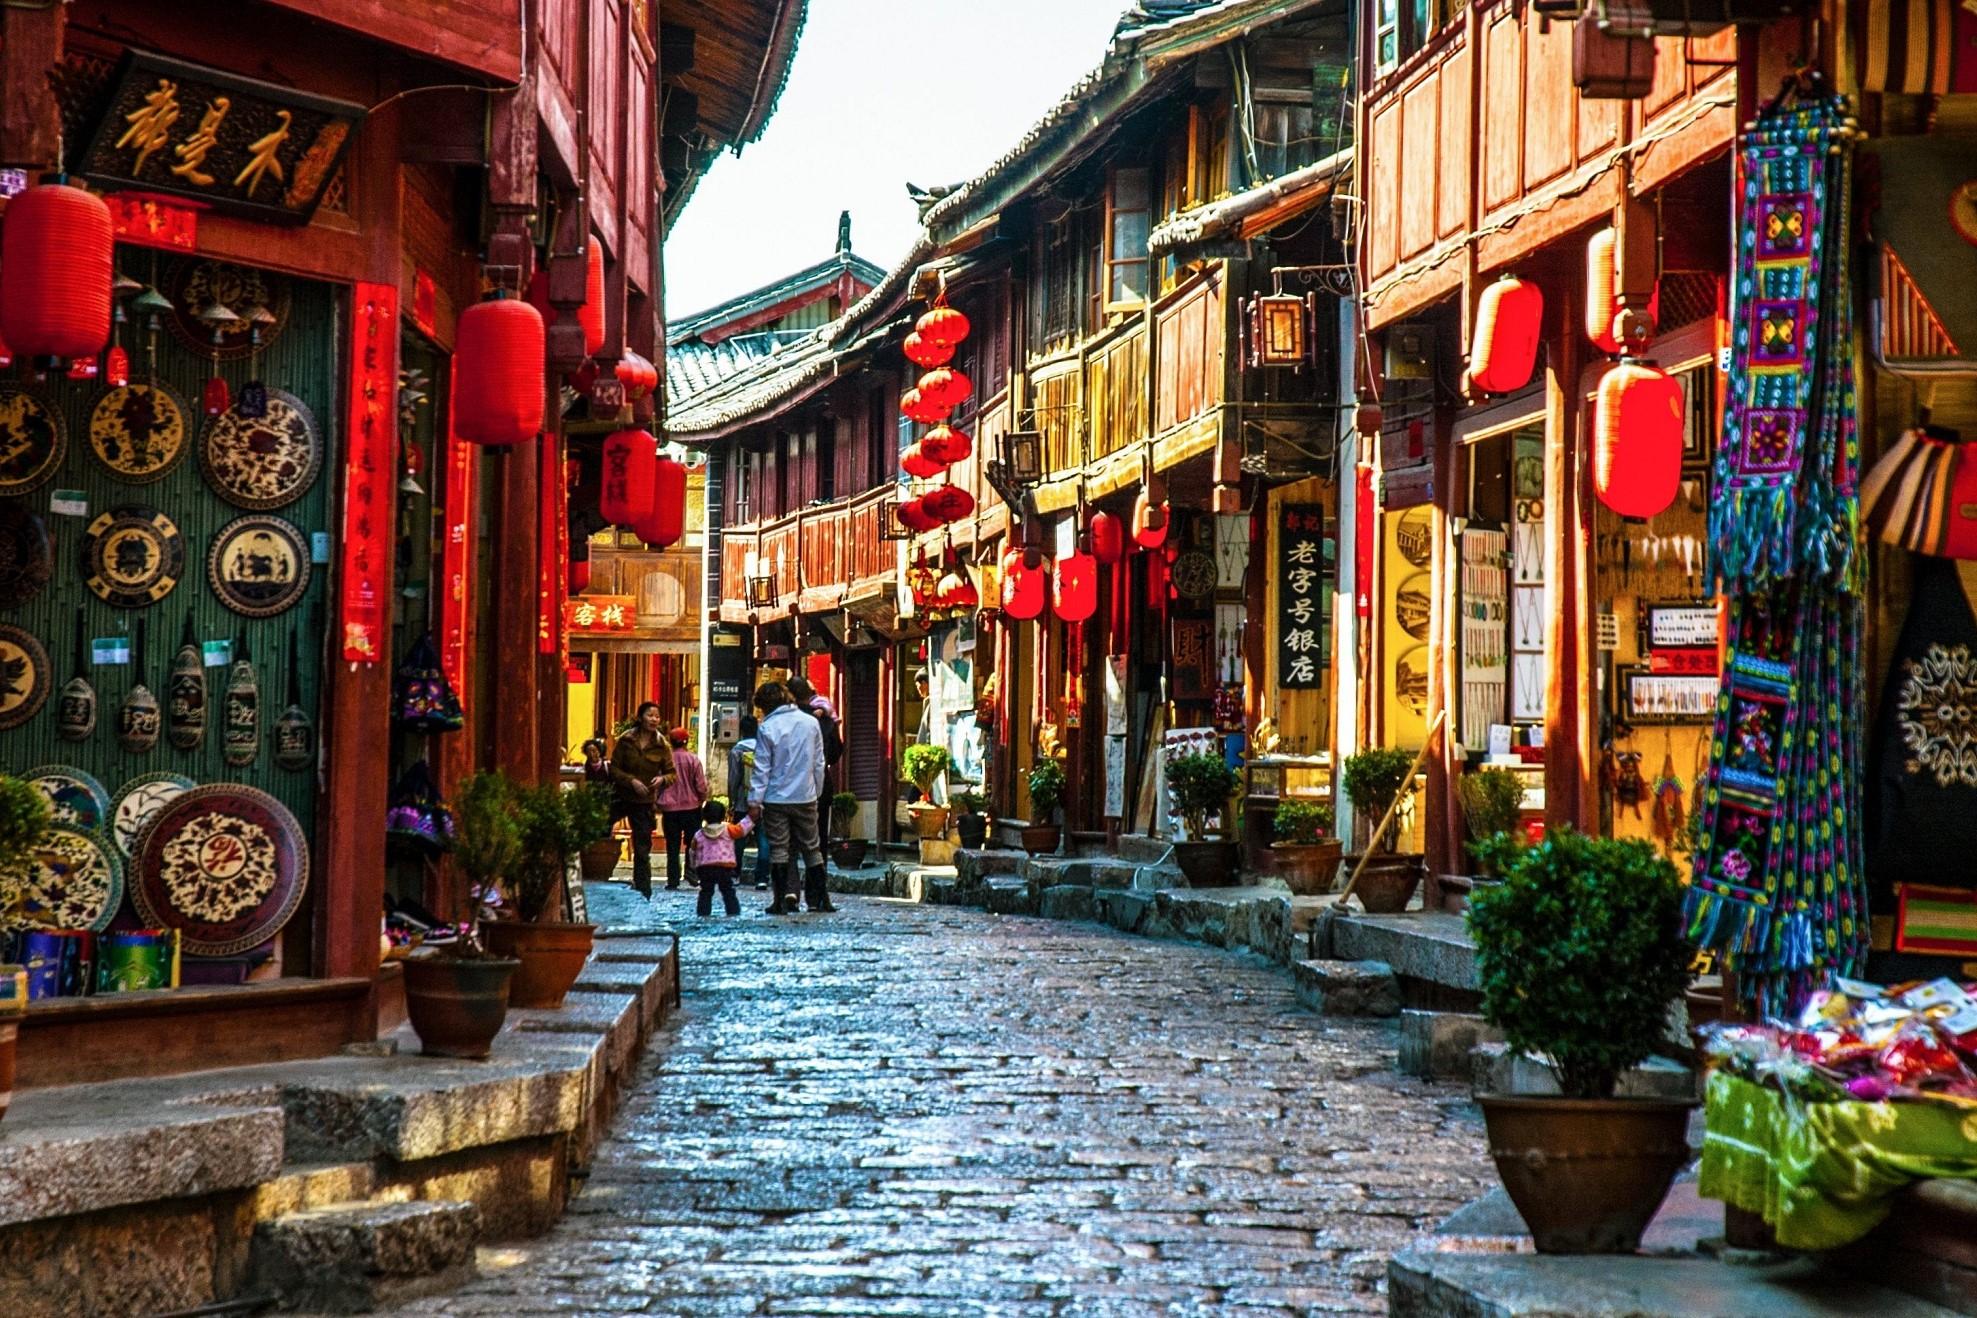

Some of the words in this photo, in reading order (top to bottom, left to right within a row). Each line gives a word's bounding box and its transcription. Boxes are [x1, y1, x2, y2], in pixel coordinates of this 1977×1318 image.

[574, 602, 625, 627] 客栈
[1284, 540, 1320, 682] 老字号银店
